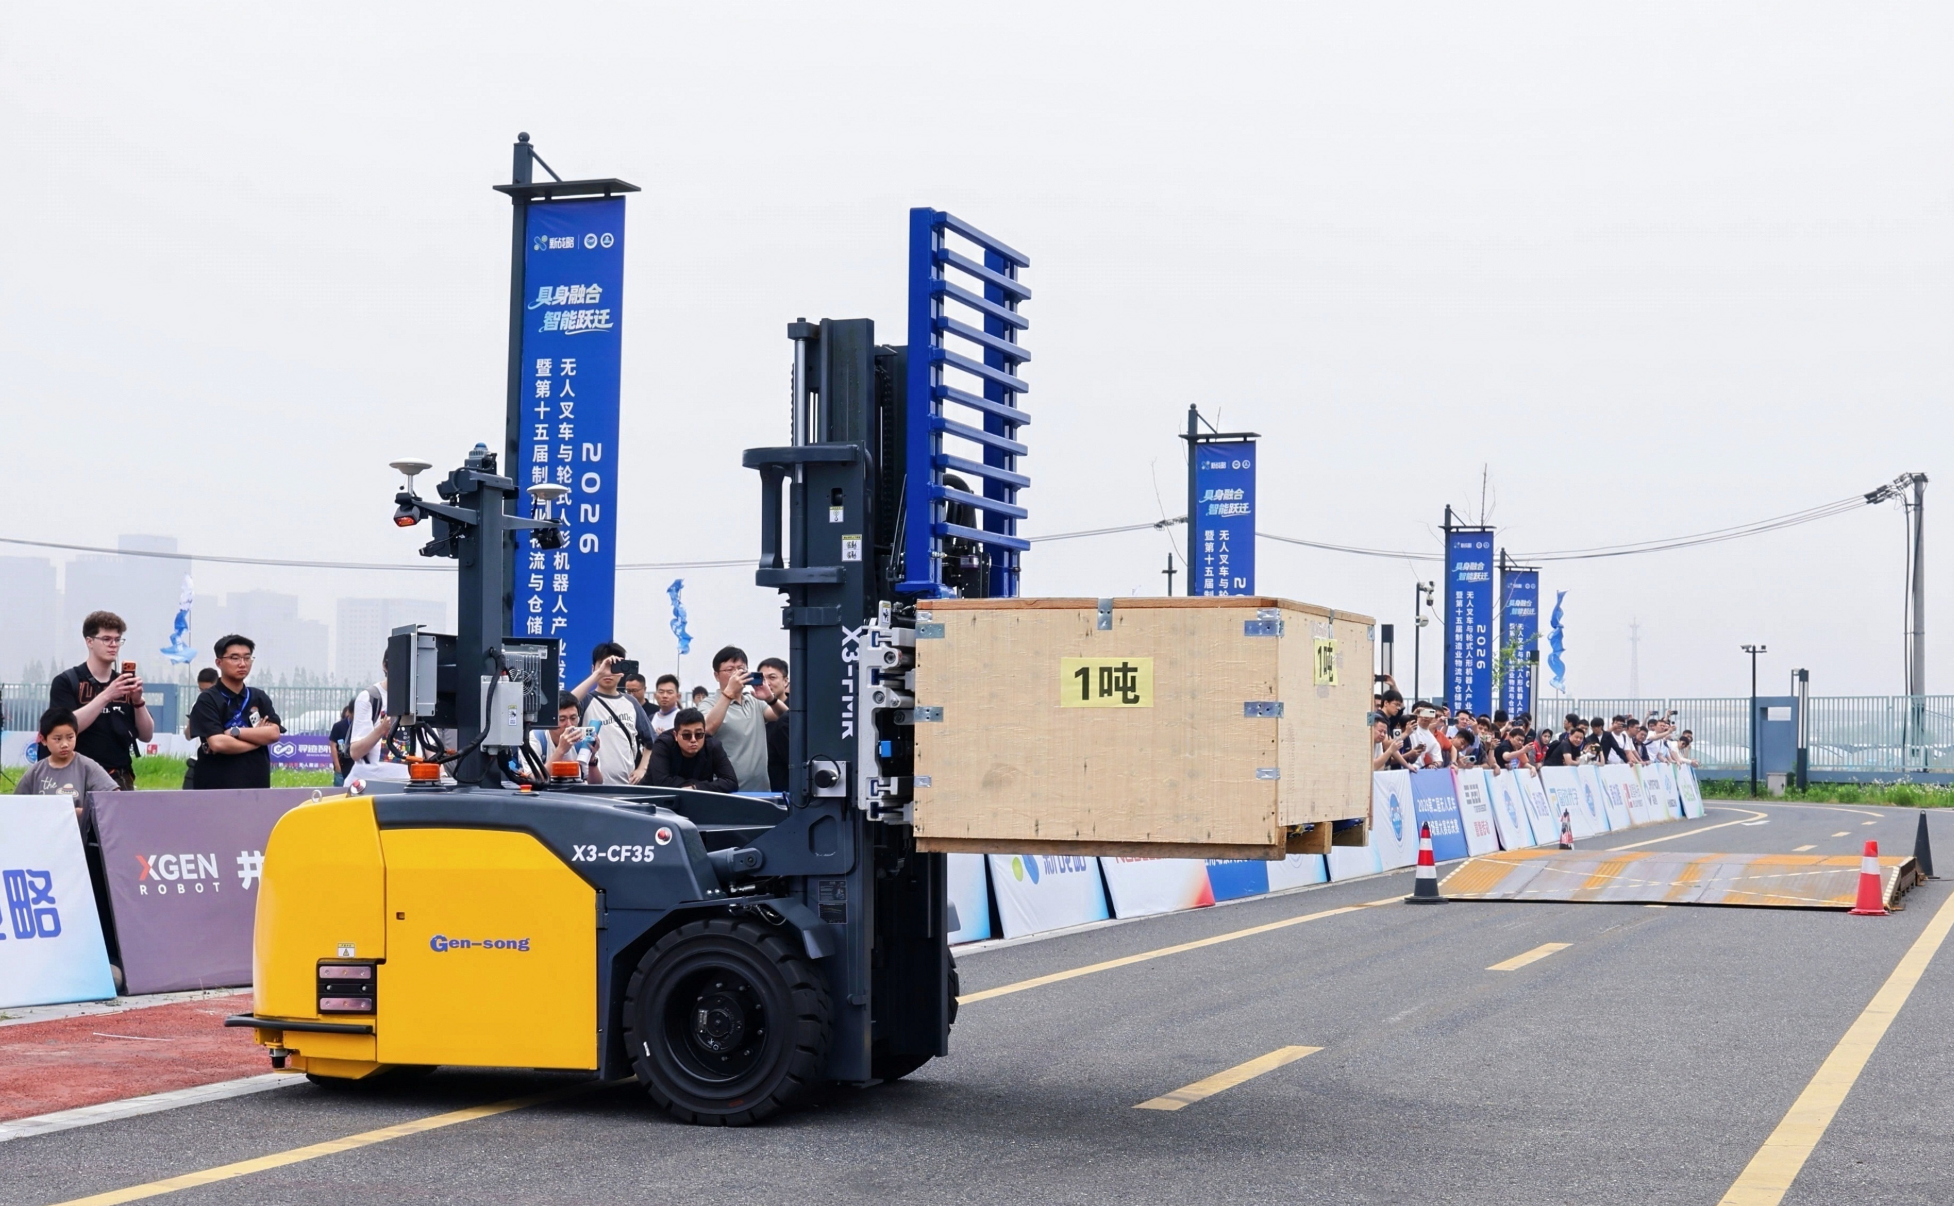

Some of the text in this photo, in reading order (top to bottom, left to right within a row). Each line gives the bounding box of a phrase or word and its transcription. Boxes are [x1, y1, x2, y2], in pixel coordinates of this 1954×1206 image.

[530, 283, 603, 309] 具身融合
[540, 309, 614, 333] 智能跃迁
[578, 442, 603, 554] 2026
[1200, 488, 1245, 503] 具身融合
[1234, 577, 1247, 597] 2
[1464, 591, 1475, 714] 无人叉车与轮式人形机器人产业
[1476, 624, 1487, 670] 2026
[1317, 642, 1334, 682] 1吨
[1074, 661, 1140, 704] 1吨
[571, 845, 655, 862] X3-CF35
[135, 853, 219, 881] XGEN
[139, 882, 220, 895] ROBOT
[430, 934, 530, 952] Gen-song
